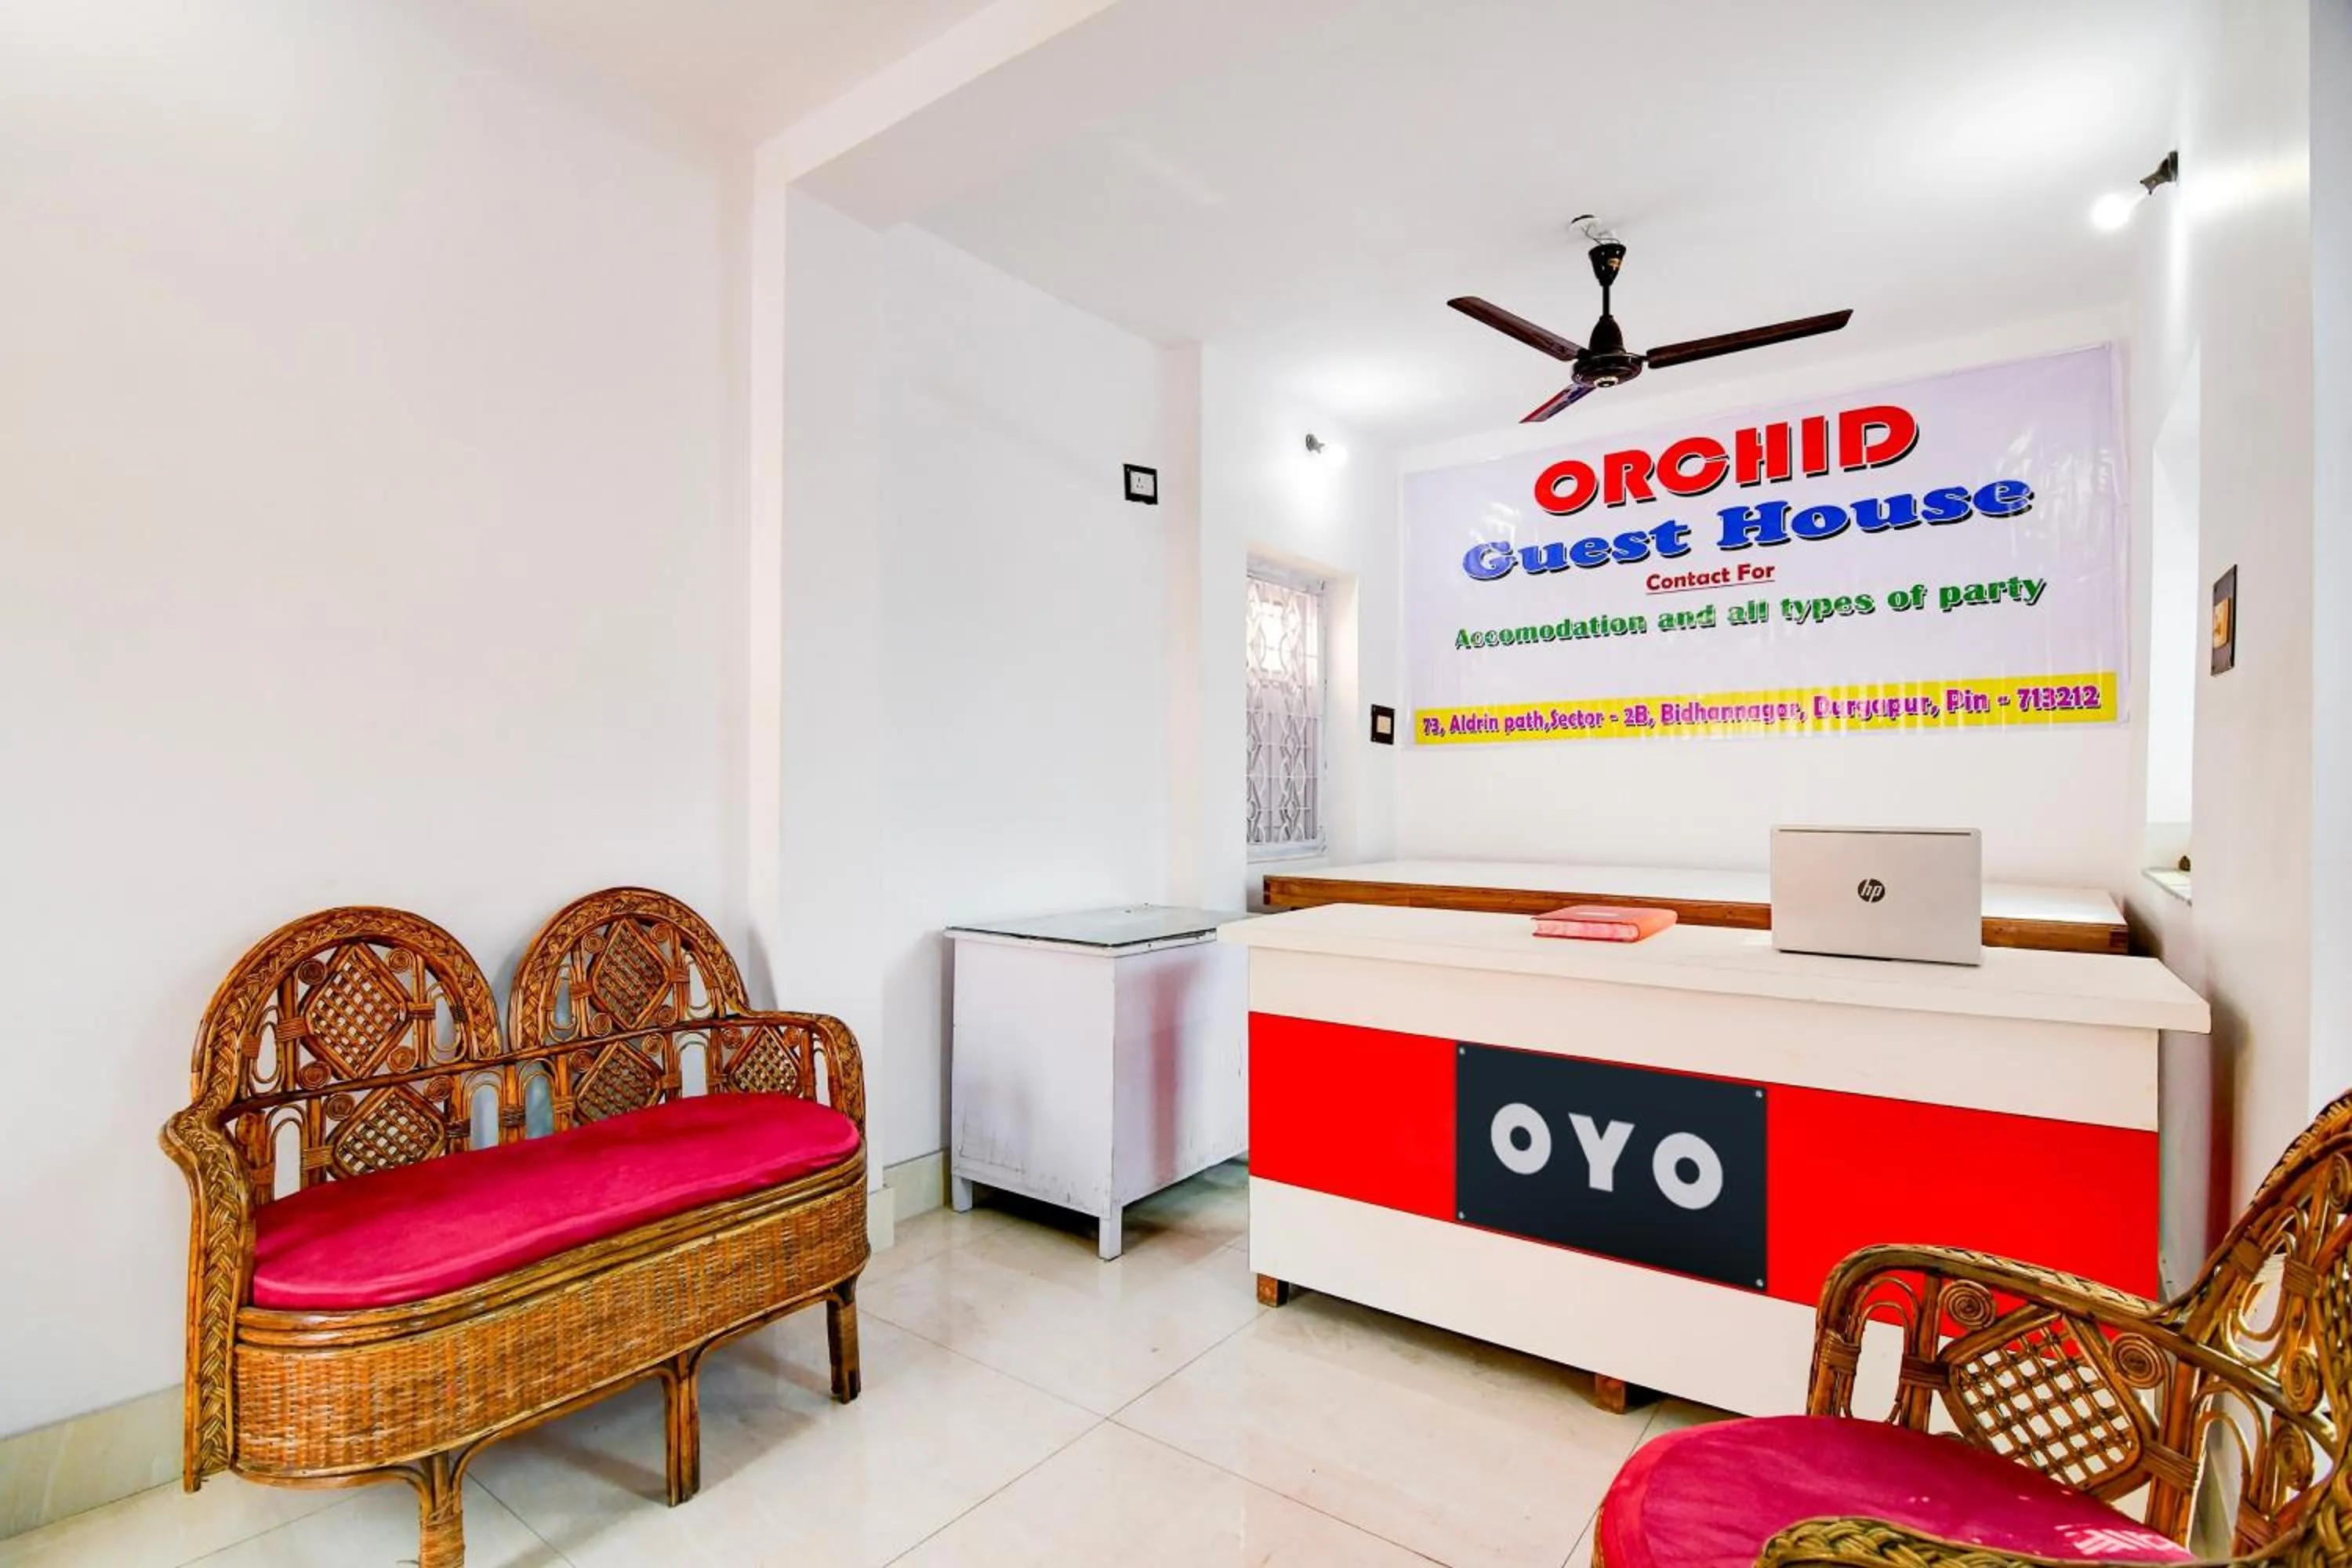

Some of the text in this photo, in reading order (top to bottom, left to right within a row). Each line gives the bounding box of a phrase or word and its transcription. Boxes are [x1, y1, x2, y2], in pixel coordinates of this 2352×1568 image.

[1534, 405, 1919, 517] ORCHID
[1462, 479, 2034, 581] Guest House
[1454, 575, 2047, 650] Accomodation and all types of party
[1646, 563, 1776, 591] Contact For
[1423, 717, 1446, 735] 73,
[1449, 713, 1499, 734] Aldrin
[1624, 706, 1655, 727] 2B,
[1946, 689, 1990, 713] Pin
[2017, 686, 2101, 710] 713212
[1860, 878, 1883, 902] hp
[1490, 1102, 1723, 1210] OYO
